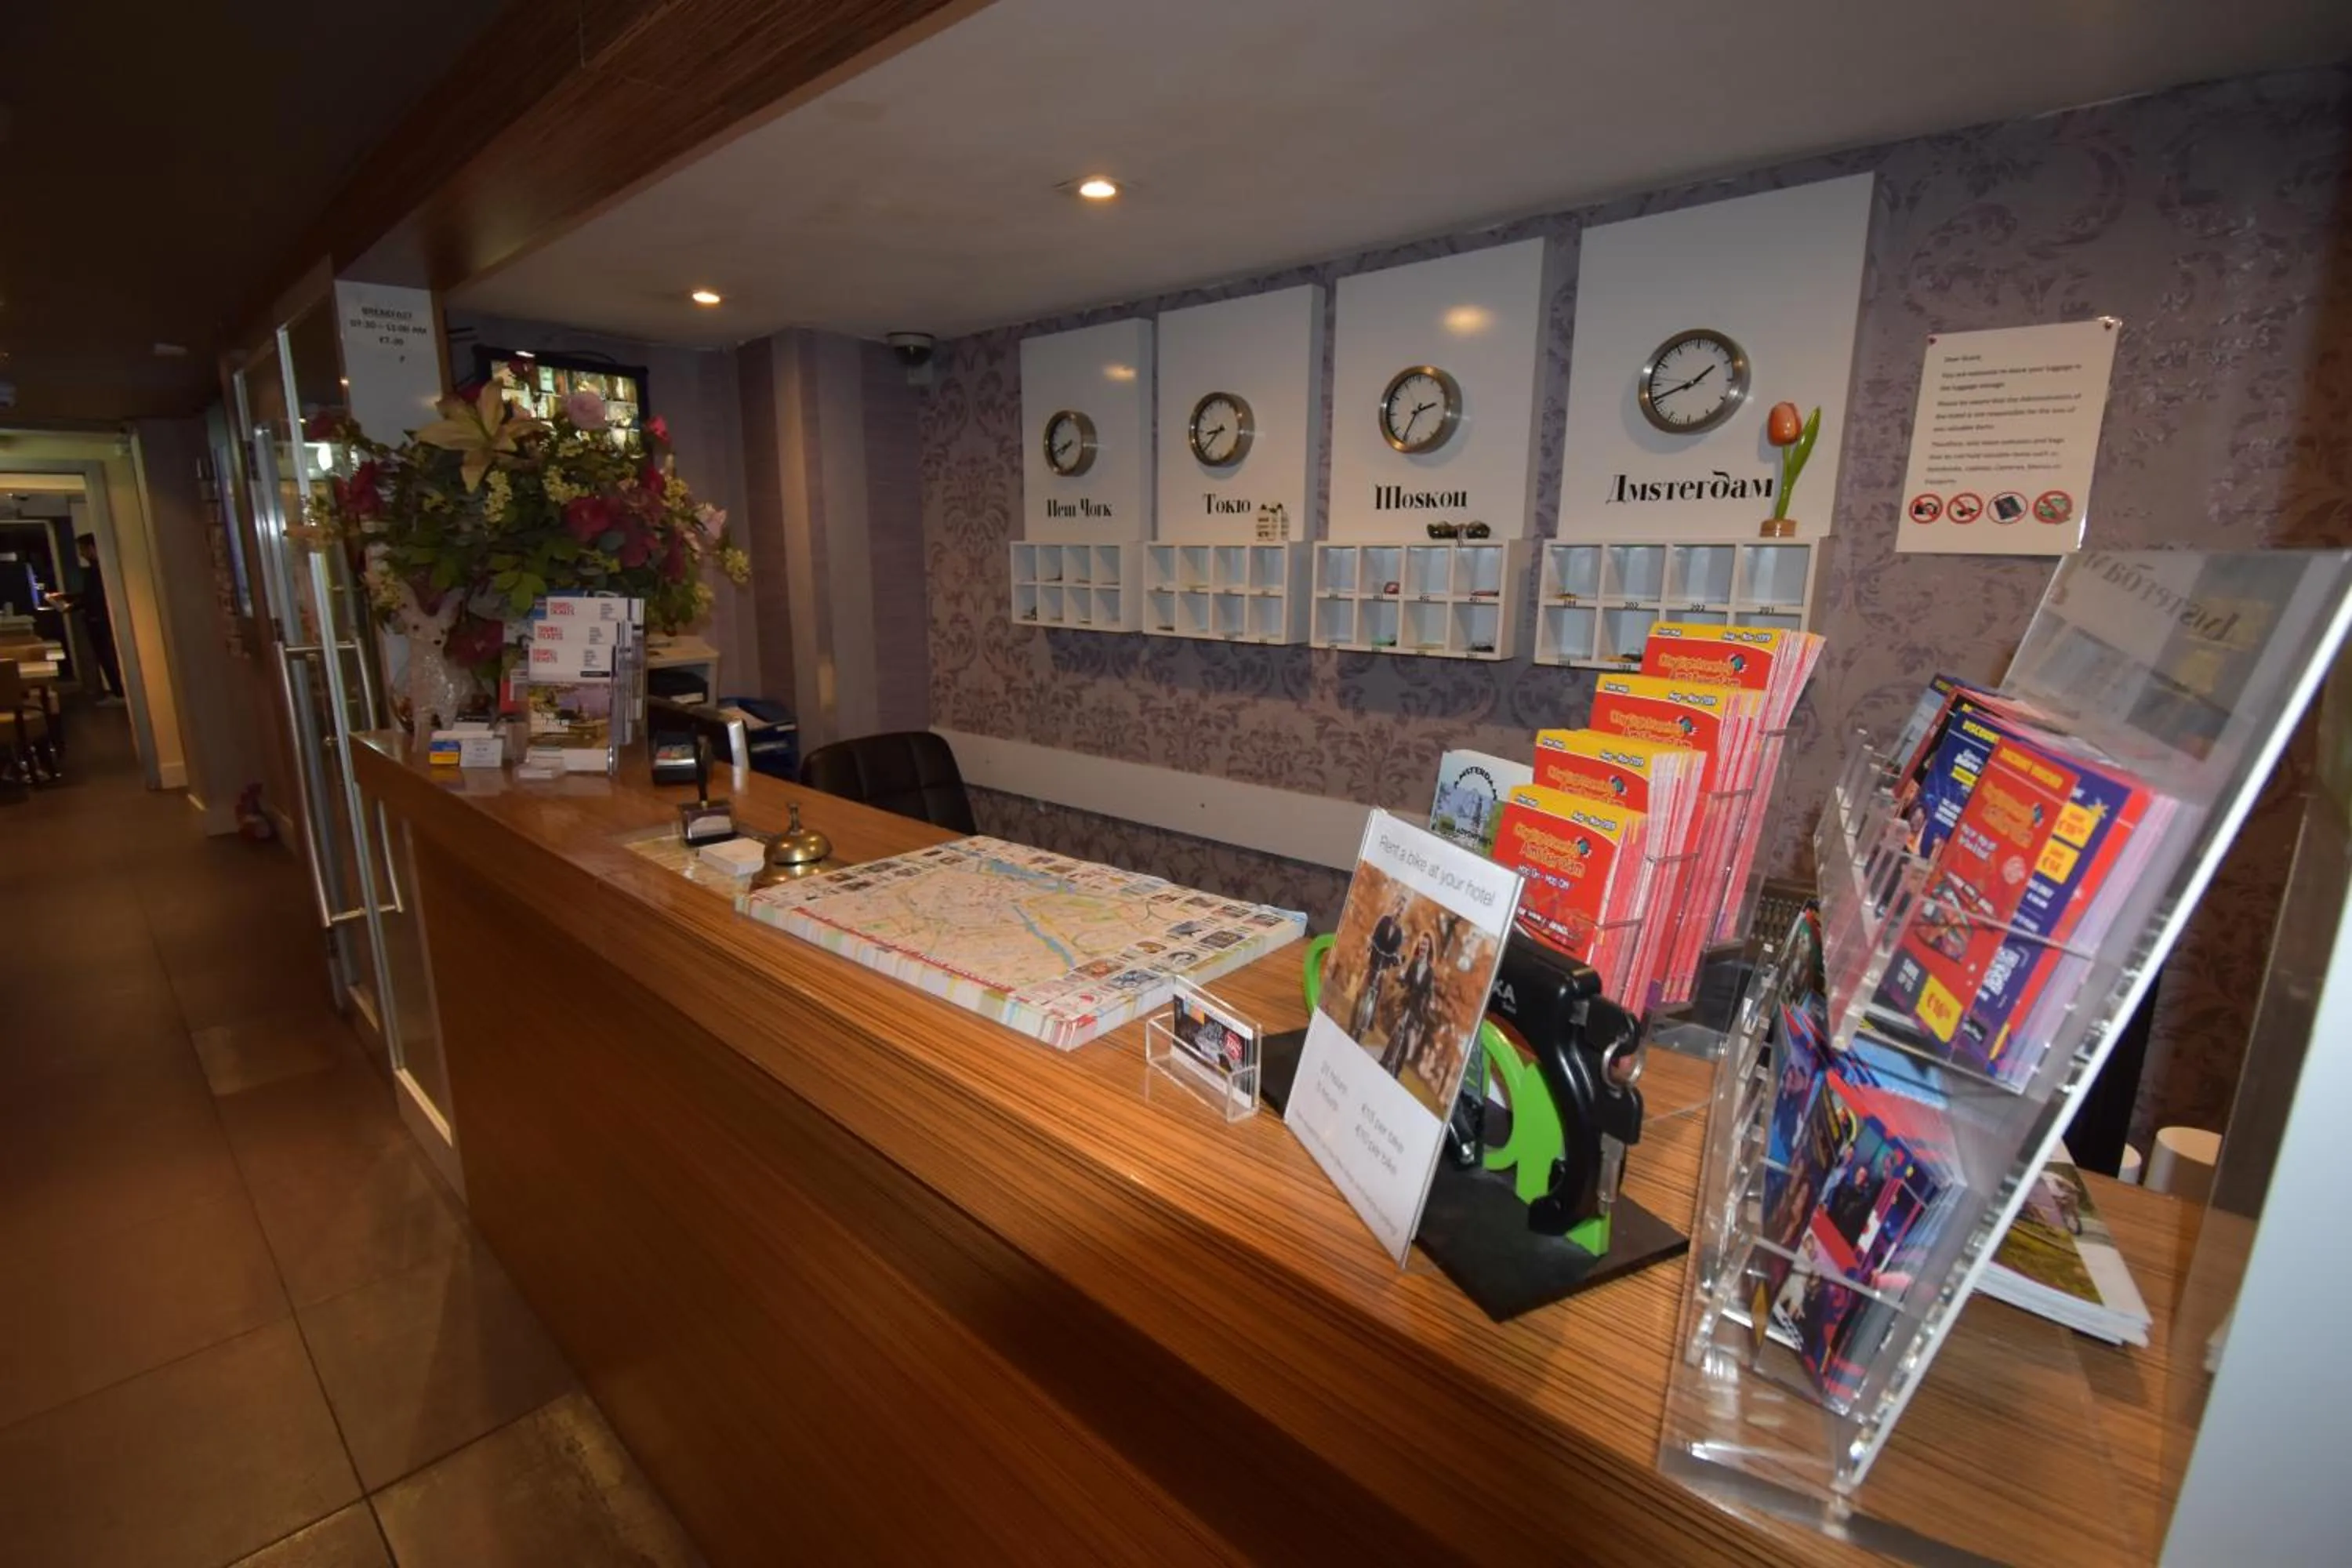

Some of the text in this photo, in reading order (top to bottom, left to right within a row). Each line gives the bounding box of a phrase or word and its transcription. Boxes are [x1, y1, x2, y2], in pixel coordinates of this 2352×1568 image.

[1379, 833, 1496, 907] Rent a bike at your hotel
